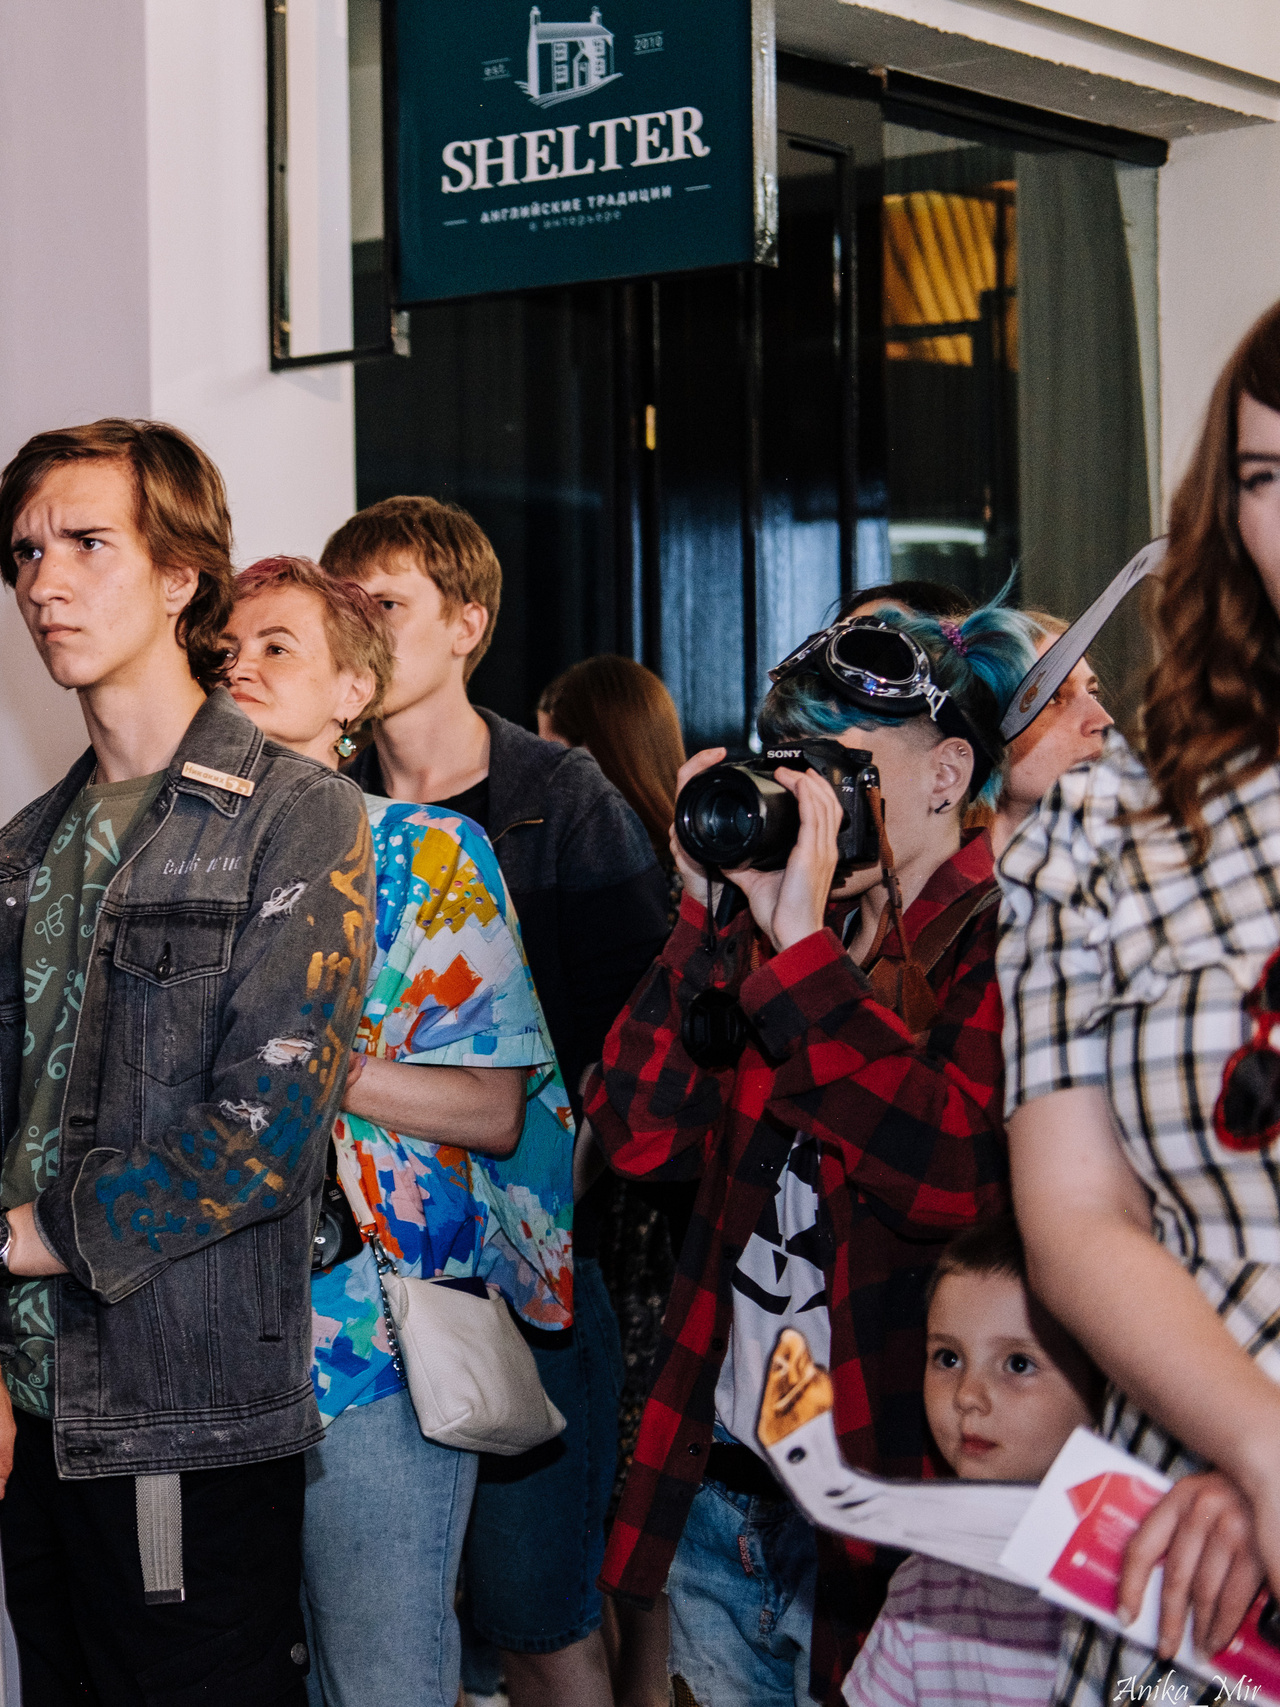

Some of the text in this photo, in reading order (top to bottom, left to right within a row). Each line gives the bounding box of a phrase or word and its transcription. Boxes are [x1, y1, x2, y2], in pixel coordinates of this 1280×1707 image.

[634, 35, 664, 51] 2010
[441, 106, 711, 194] SHELTER
[480, 185, 672, 224] АНГЛИЙСКИЕ ТРАДИЦИИ
[766, 749, 802, 759] SONY
